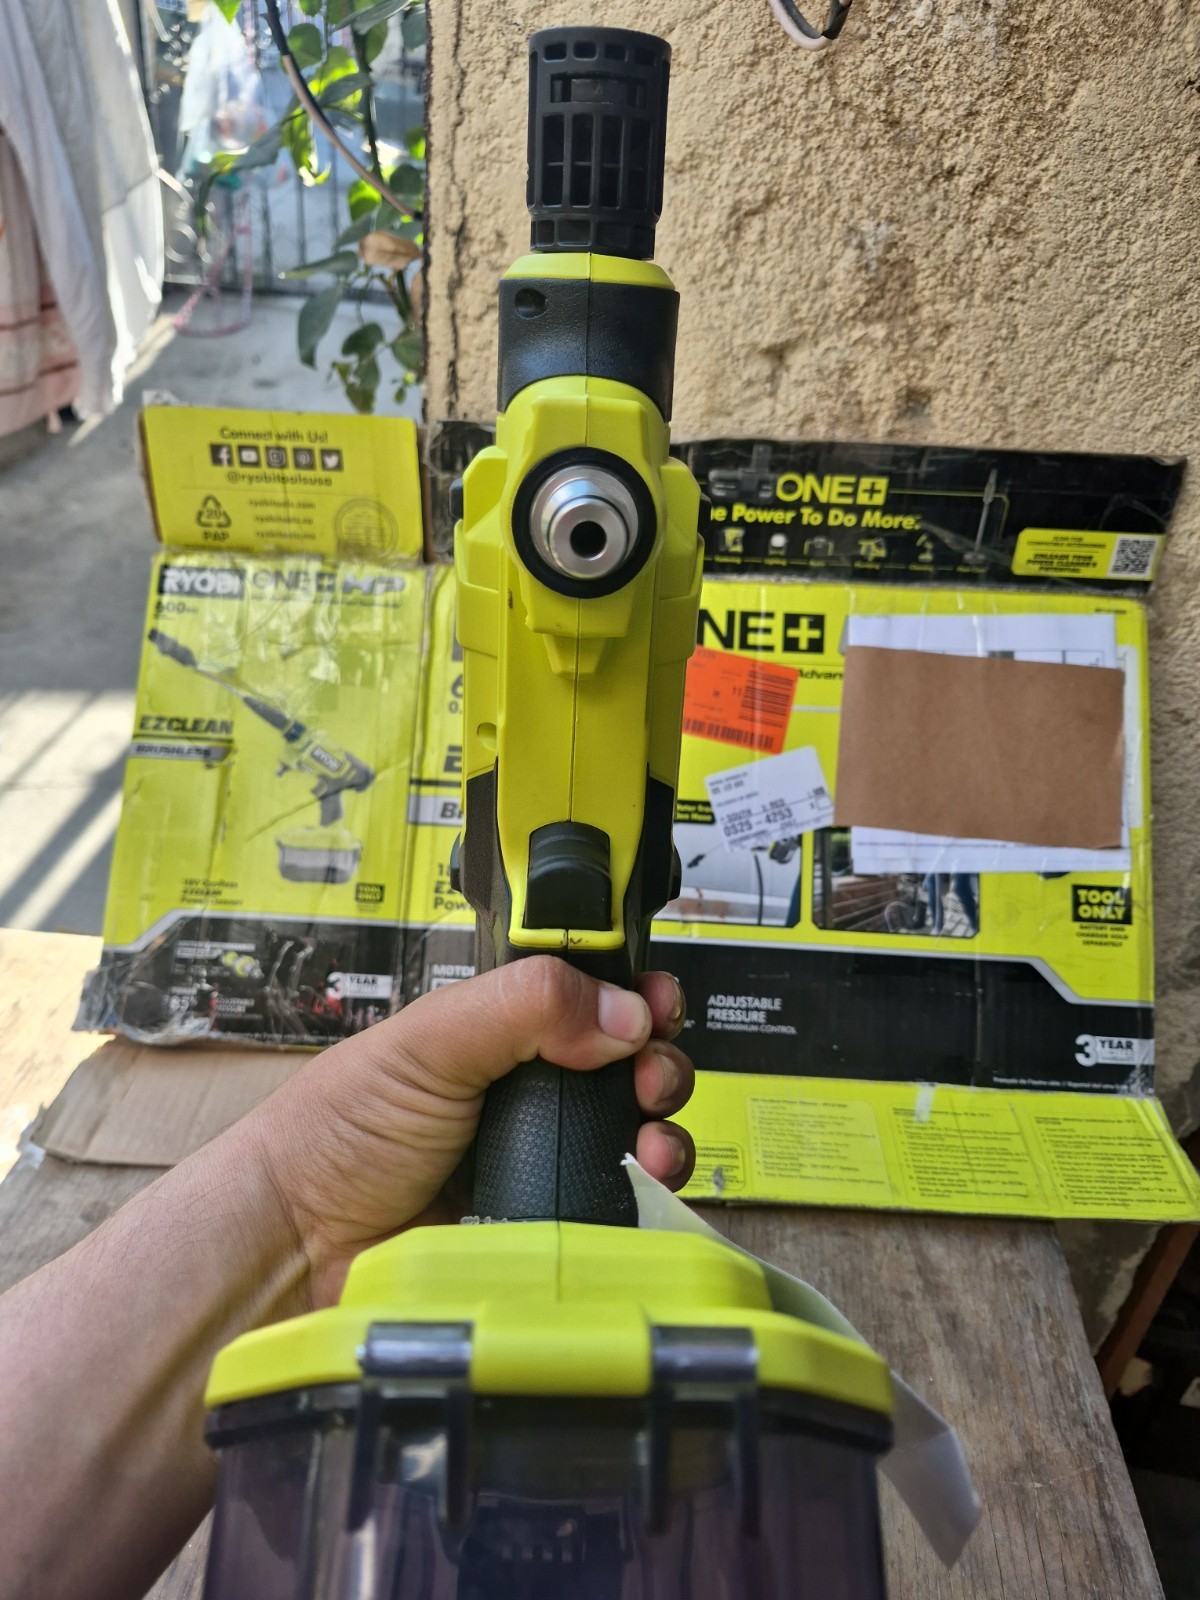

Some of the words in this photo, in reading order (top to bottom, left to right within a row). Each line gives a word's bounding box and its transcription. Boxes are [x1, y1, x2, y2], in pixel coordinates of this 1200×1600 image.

[219, 426, 273, 440] Connect
[276, 429, 304, 441] with
[732, 502, 797, 525] Power
[800, 505, 824, 526] To
[827, 507, 856, 527] Do
[861, 509, 921, 531] More.
[163, 568, 241, 594] RYOBI
[140, 714, 234, 736] EZCLEAN
[1077, 889, 1125, 905] TOOL
[1078, 904, 1126, 920] ONLY
[350, 975, 379, 985] YEAR
[707, 994, 783, 1011] ADJUSTABLE
[707, 1008, 767, 1024] PRESSURE
[706, 1021, 722, 1030] FOR
[760, 1024, 797, 1035] CONTROL
[1075, 1034, 1098, 1067] 3
[1100, 1040, 1133, 1051] YEAR
